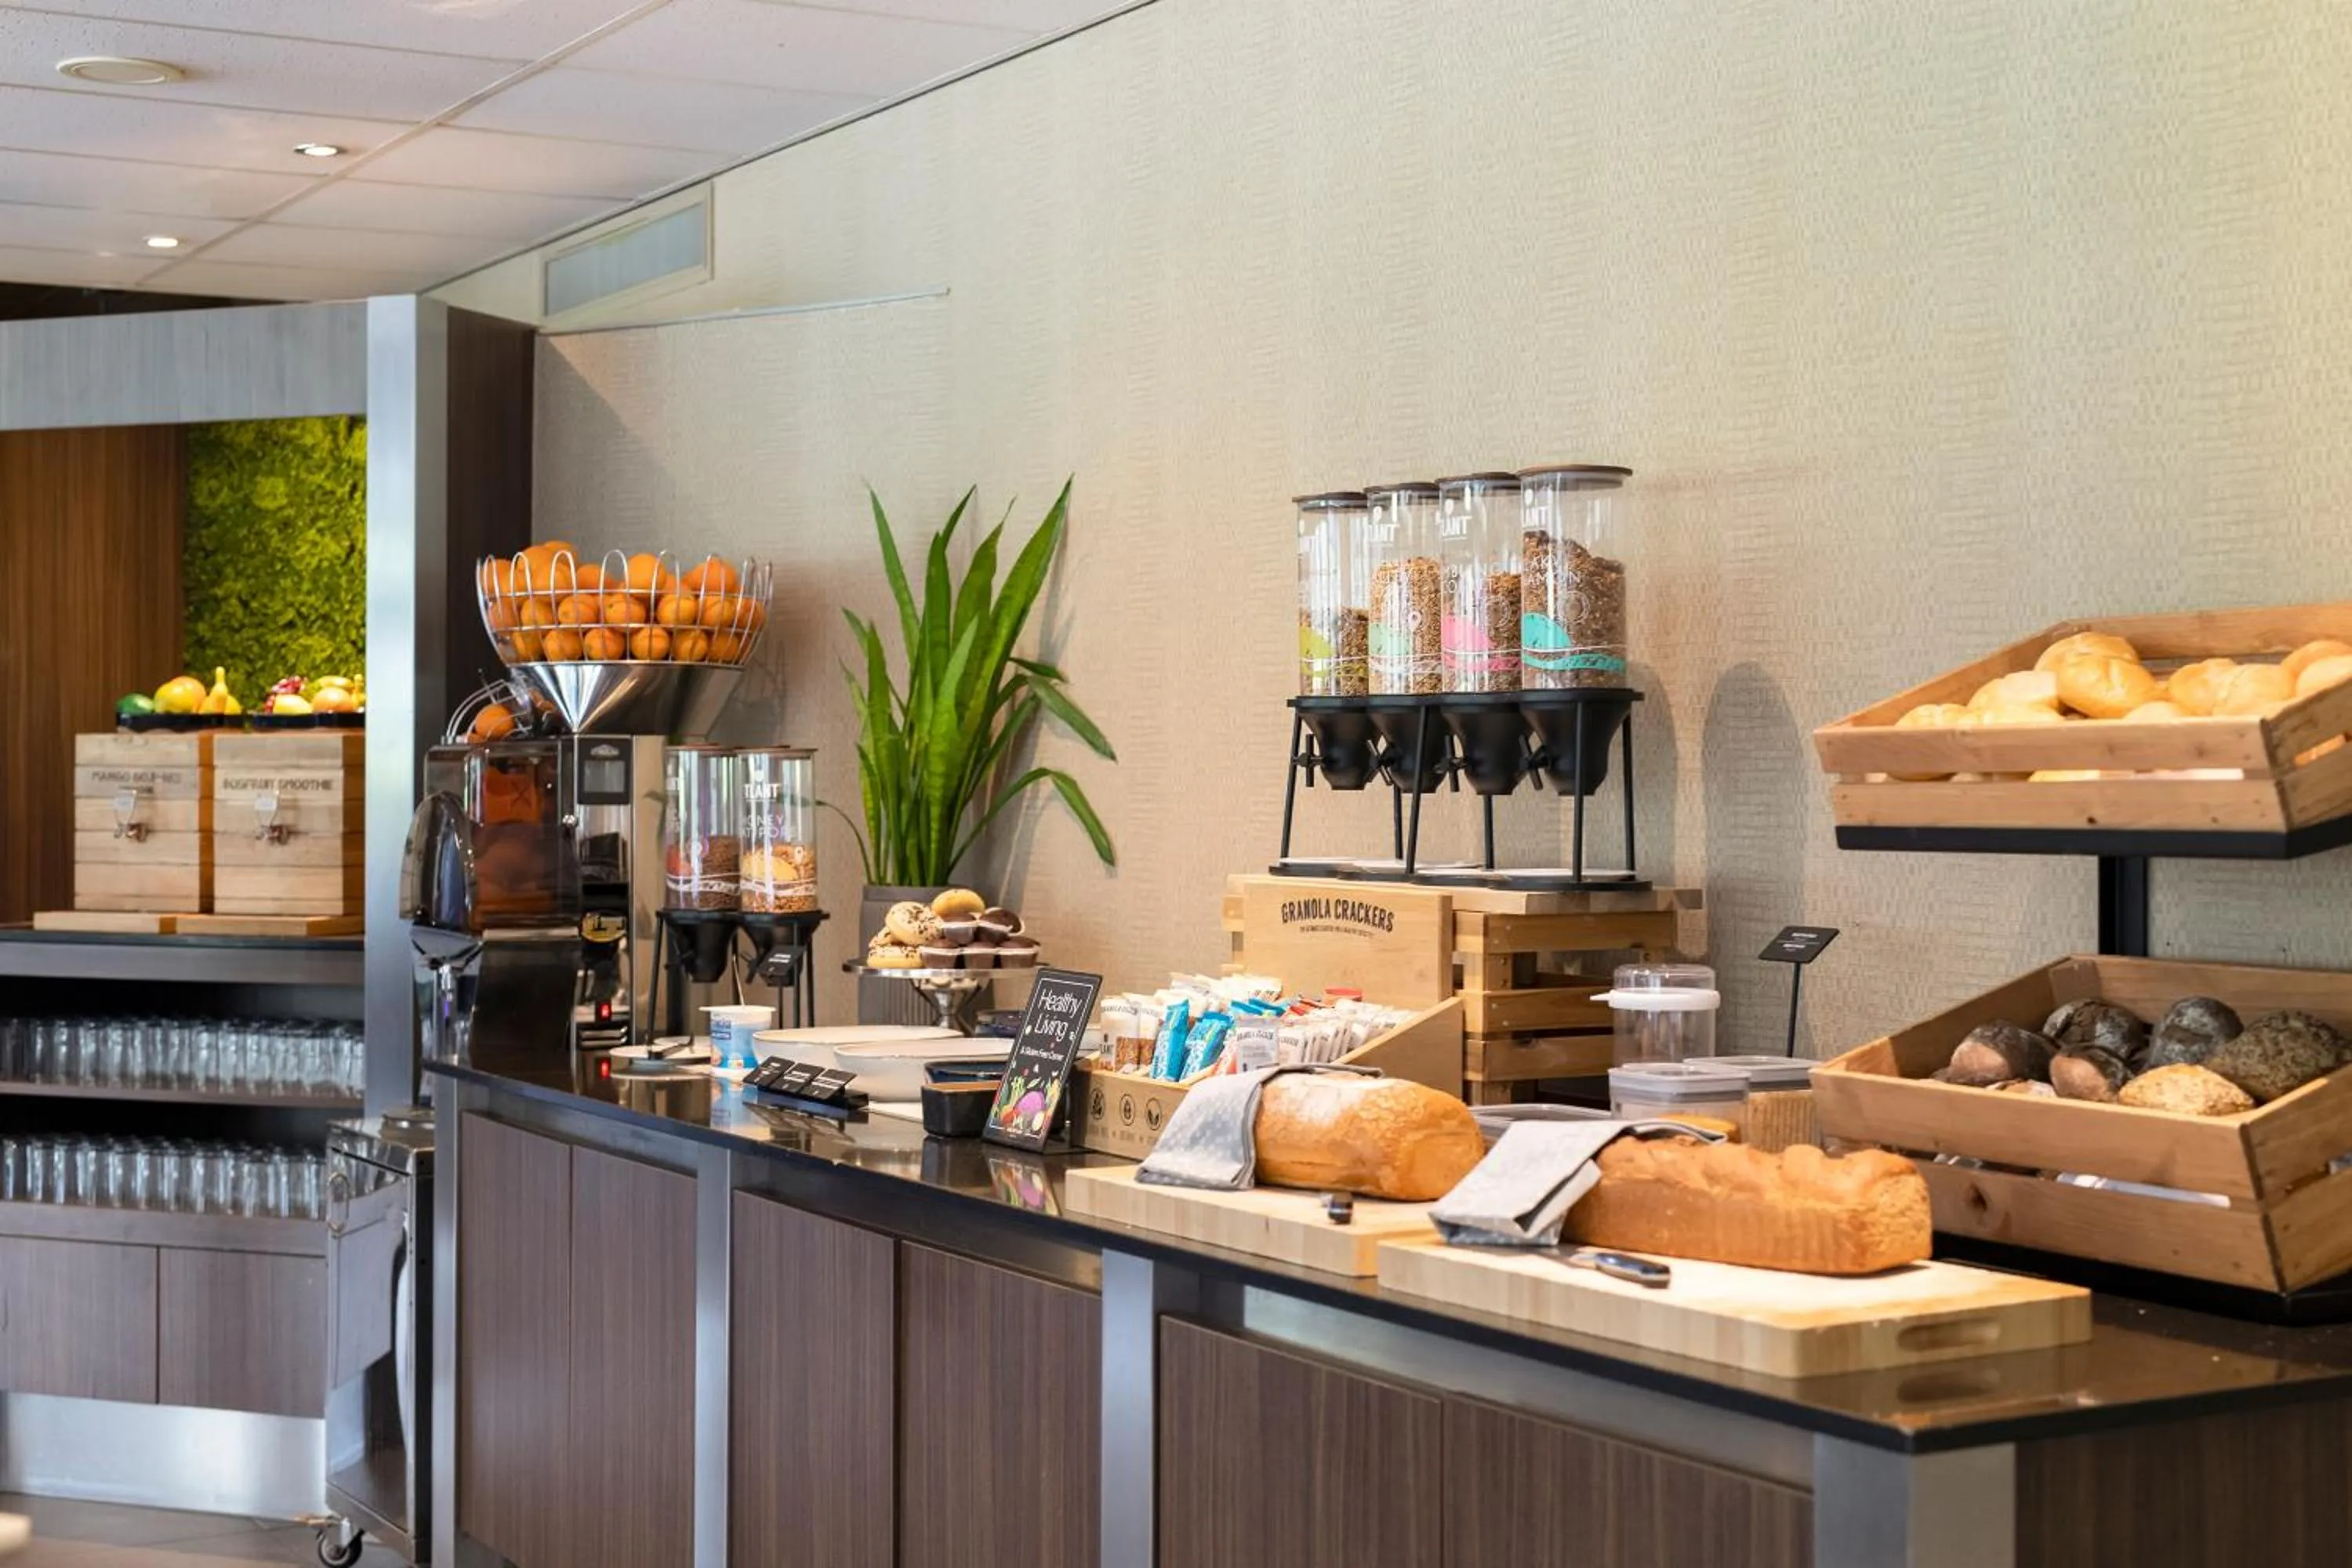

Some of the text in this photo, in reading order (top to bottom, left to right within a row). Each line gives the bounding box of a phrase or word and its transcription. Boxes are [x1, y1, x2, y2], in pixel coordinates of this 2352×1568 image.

[1281, 898, 1331, 924] GRANOLA
[1334, 898, 1395, 933] CRACKERS
[1037, 988, 1083, 1019] Healthy
[1034, 1012, 1069, 1043] Living
